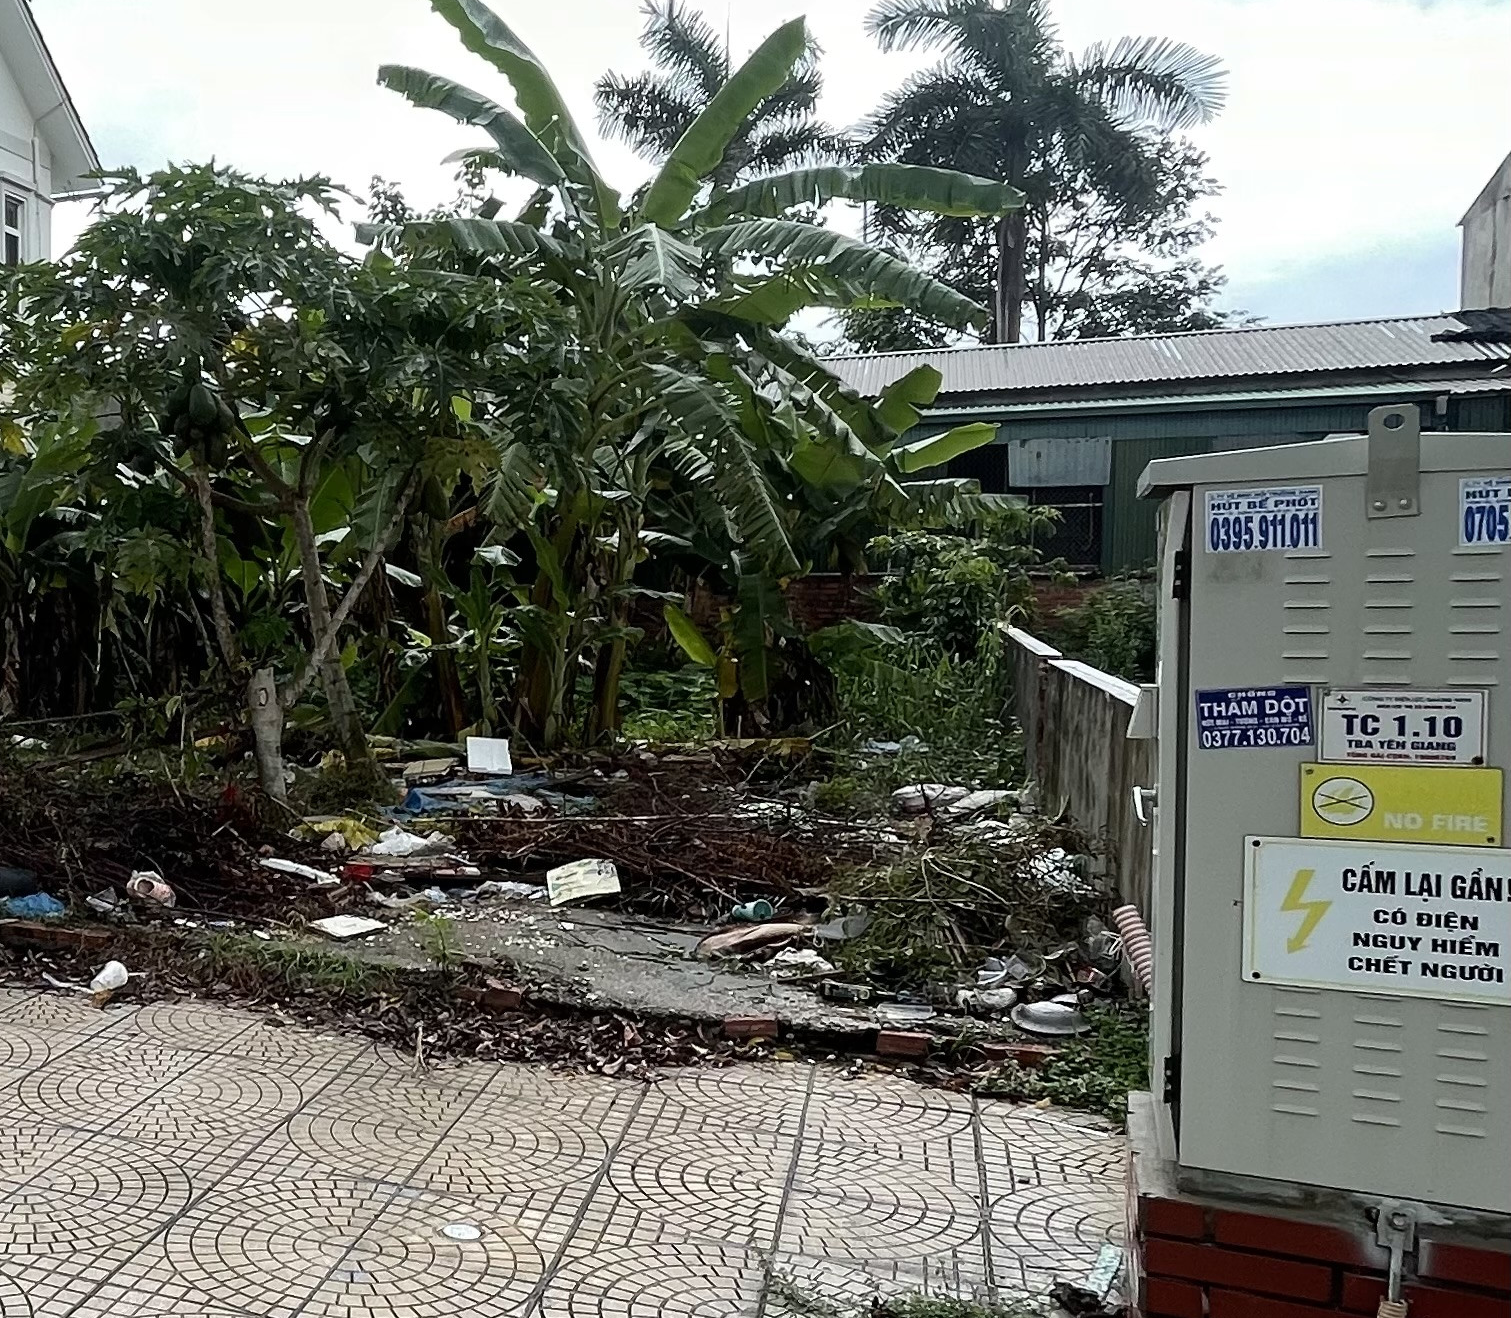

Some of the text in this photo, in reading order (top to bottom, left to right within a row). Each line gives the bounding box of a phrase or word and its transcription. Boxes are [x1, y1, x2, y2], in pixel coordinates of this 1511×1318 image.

[1211, 512, 1318, 551] 0395.911.011
[1264, 695, 1309, 716] DỘT
[1202, 726, 1311, 748] 0377.130.704
[1341, 714, 1463, 738] TC 1.10
[1378, 739, 1406, 750] YÊN
[1411, 741, 1456, 751] GIANG
[1384, 813, 1487, 832] NO FIRE
[1342, 860, 1396, 895] CẤM
[1404, 871, 1442, 902] LẠI
[1373, 907, 1479, 933] CÓ ĐIỆN
[1353, 932, 1500, 957] NGUY HIỂM
[1348, 955, 1503, 983] CHẾT NGƯỜI
